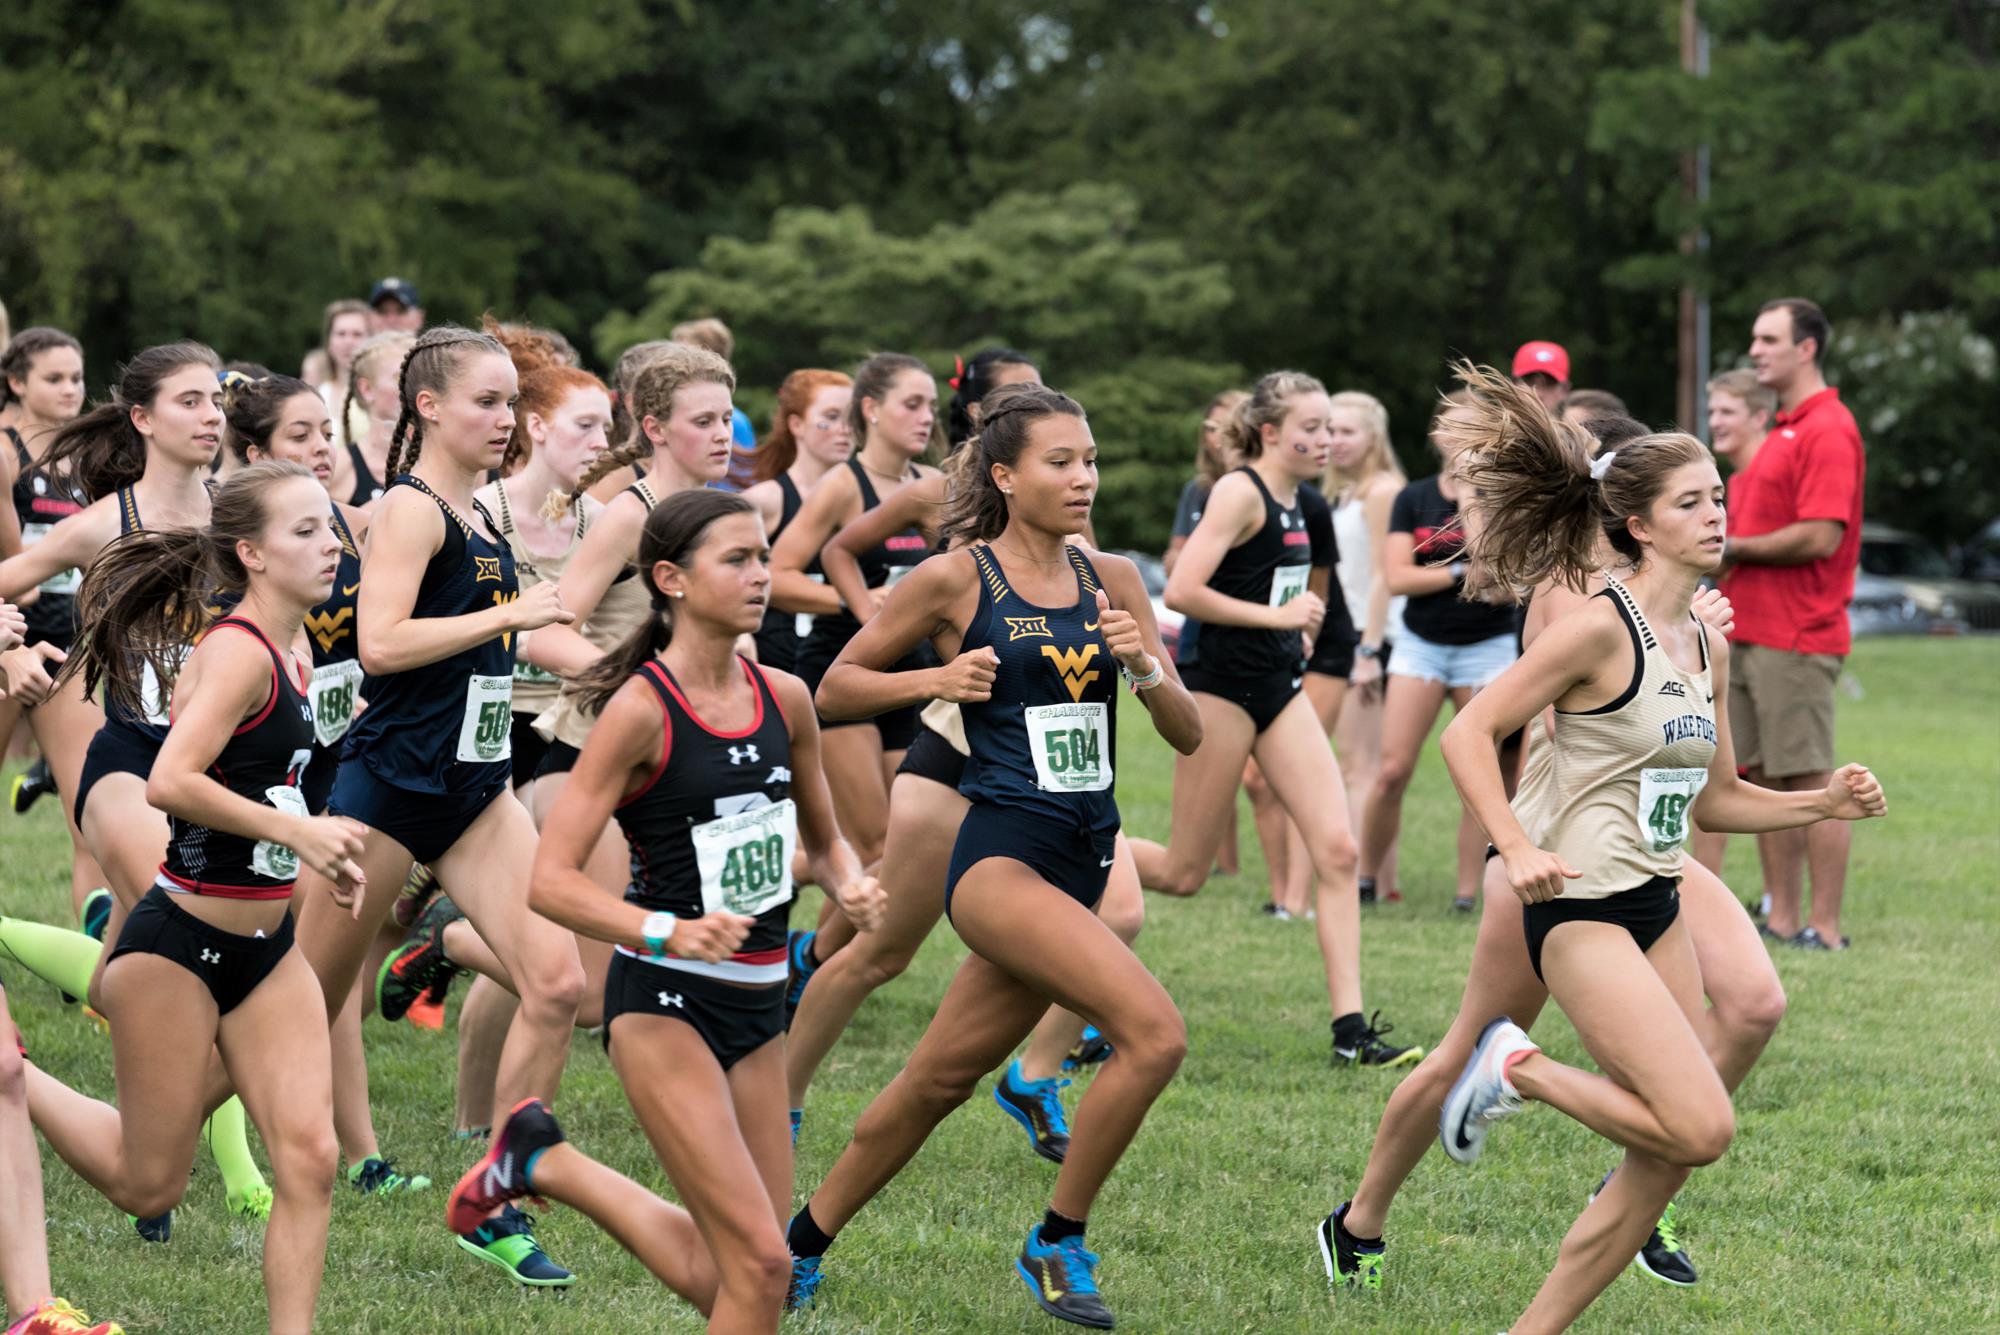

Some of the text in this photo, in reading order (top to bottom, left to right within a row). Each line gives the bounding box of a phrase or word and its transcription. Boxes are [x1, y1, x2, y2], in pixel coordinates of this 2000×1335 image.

[316, 681, 354, 726] 498
[1659, 681, 1686, 695] ACC
[475, 700, 512, 743] 50
[1039, 705, 1102, 719] CHARLOTTE
[1662, 714, 1696, 746] WAKE
[1044, 728, 1101, 773] 504
[720, 833, 784, 895] 460
